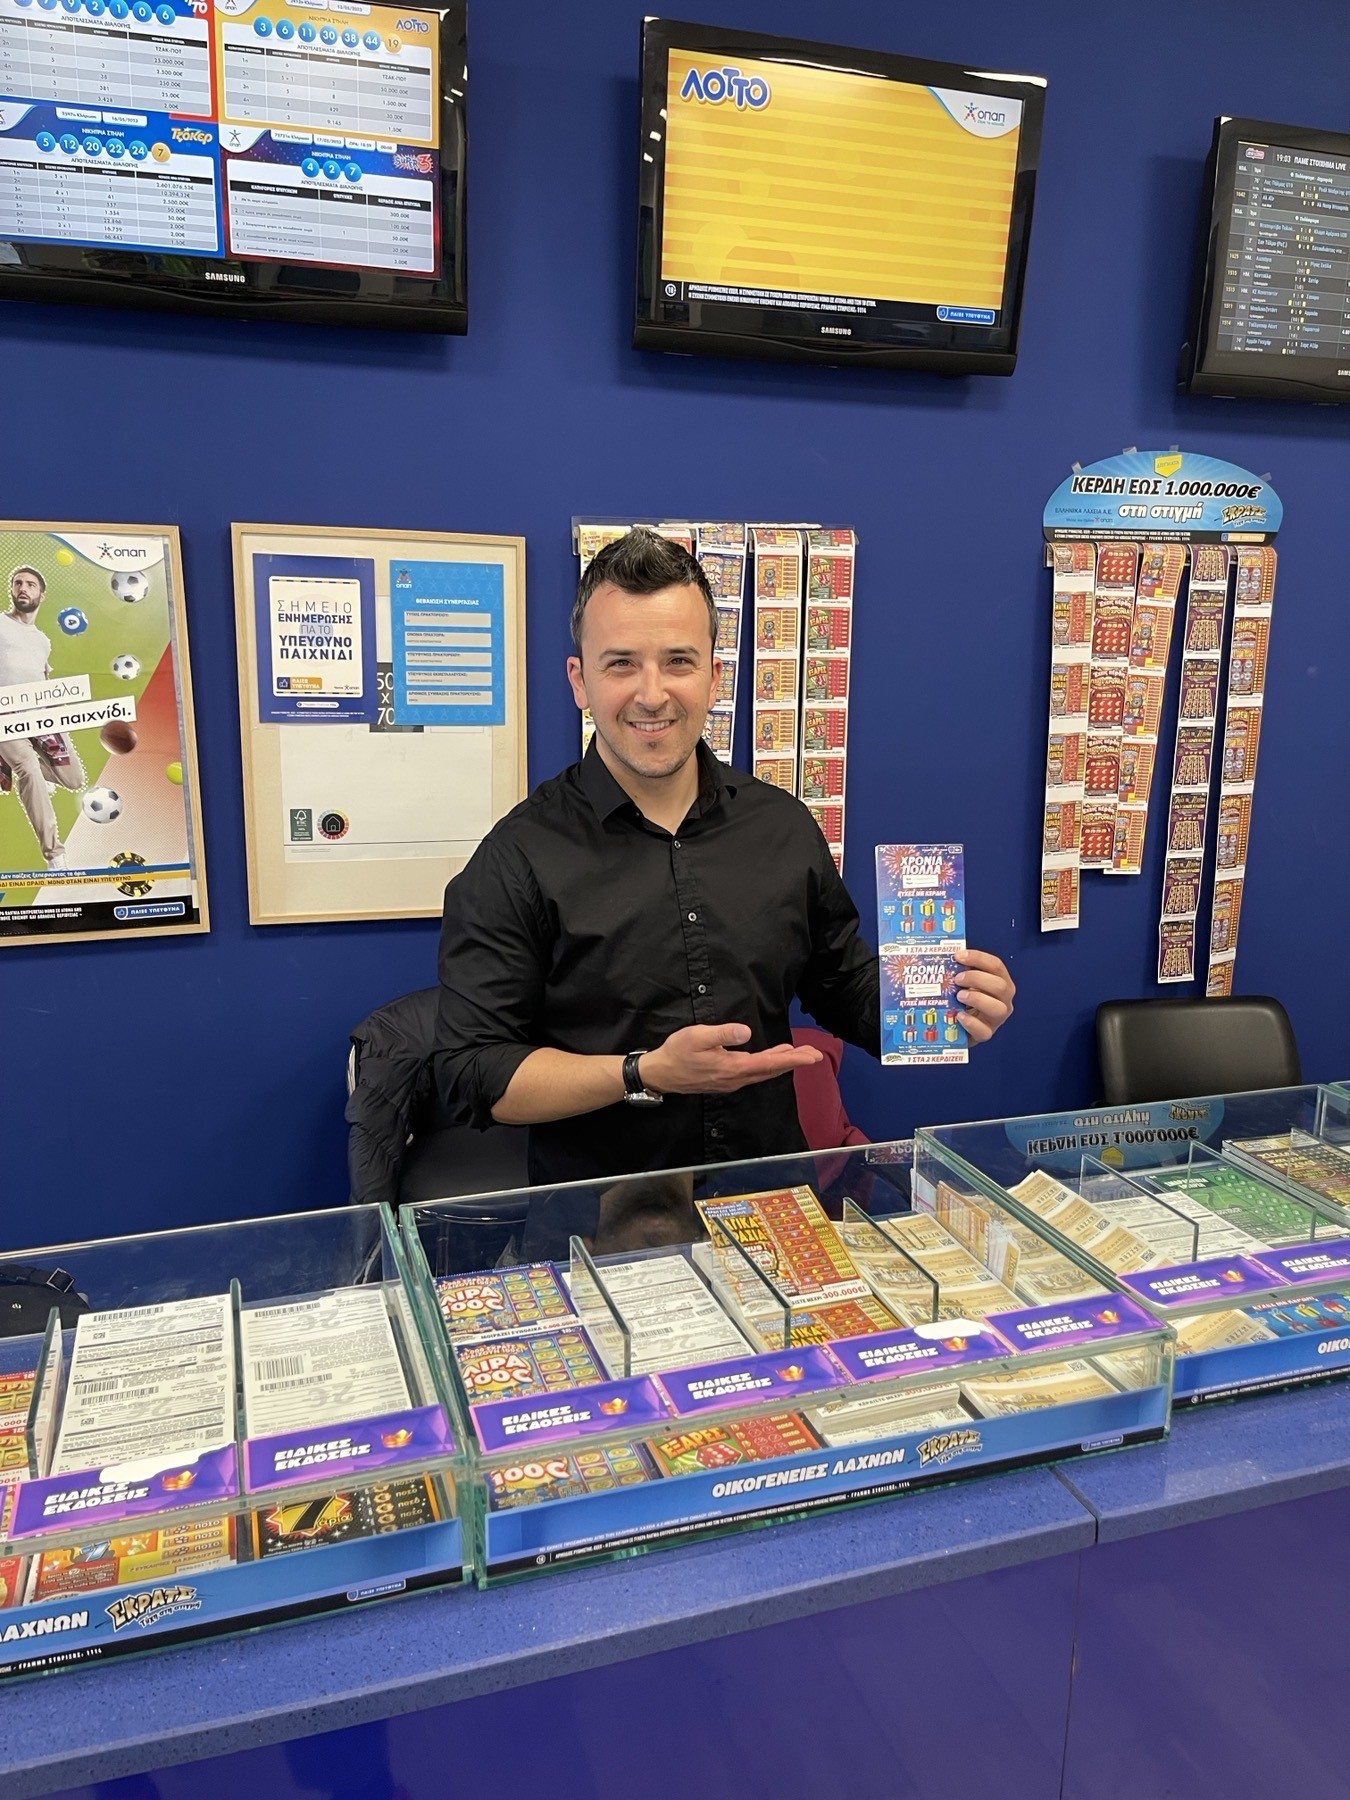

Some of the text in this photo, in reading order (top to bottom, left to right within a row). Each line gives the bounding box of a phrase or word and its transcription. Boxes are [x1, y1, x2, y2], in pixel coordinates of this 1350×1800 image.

[92, 1, 99, 11] 2
[116, 4, 122, 14] 1
[138, 7, 146, 17] 0
[162, 10, 170, 20] 6
[396, 18, 429, 34] ΛΟΤΤΟ
[260, 22, 399, 48] 3 6 11 30 38 44 19
[680, 66, 770, 109] ΛΟΤΤΟ
[42, 138, 164, 157] 5 12 20 22 24 7
[307, 162, 356, 176] 4 2 7
[1276, 154, 1347, 171] 19:03 ΠΑΜΕ ΣΤΟΙΧΗΜΑ LIVE
[205, 272, 246, 283] SAMSUNG
[965, 312, 991, 320] ΥΠΕΥΘΥΝΑ
[820, 326, 852, 336] SAMSUNG
[1071, 476, 1262, 499] ΚΕΡΔΗ ΕΩΣ 1.000.000€
[1054, 507, 1082, 515] ΕΛΛΗΝΙΚΑ
[1118, 501, 1204, 523] στη στιγμή
[1221, 504, 1268, 525] ΣΚΡΑΤΣ
[114, 547, 147, 558] οπαπ
[278, 600, 352, 614] ΣΗΜΕΙΟ
[444, 598, 479, 606] ΣΥΝΕΡΓΑΣΙΑΣ
[278, 613, 353, 624] ΕΝΗΜΕΡΩΣΗΣ
[301, 625, 331, 634] ΓΙΑ ΤΟ
[279, 635, 352, 647] ΥΠΕΥΘΥΝΟ
[280, 648, 352, 660] ΠΑΙΧΝΙΔΙ
[377, 673, 394, 690] 50
[20, 693, 29, 705] η
[34, 682, 85, 705] μπάλα,
[381, 692, 390, 704] x
[4, 702, 132, 735] και το παιχνίδι.
[377, 707, 395, 726] 70
[900, 856, 943, 866] ΧΡΟΝΙΑ
[12, 872, 32, 880] παίζεις
[32, 871, 67, 880] ξεπερνώντας
[902, 865, 941, 875] ΠΟΛΛΑ
[149, 906, 180, 914] ΥΠΕΥΘΥΝΑ
[910, 946, 923, 954] ΣΤΑ
[902, 965, 946, 975] ΧΡΟΝΙΑ
[904, 974, 944, 984] ΠΟΛΛΑ
[1281, 1254, 1332, 1268] ΕΙΔΙΚΕΣ
[1290, 1258, 1350, 1273] ΕΚΔΟΣΕΙΣ
[1149, 1275, 1201, 1290] ΕΙΔΙΚΕΣ
[1157, 1279, 1220, 1296] ΕΚΔΟΣΕΙΣ
[441, 1287, 499, 1307] ΛΙΡΑ
[822, 1286, 867, 1299] 300.000€!
[1015, 1315, 1074, 1333] ΕΙΔΙΚΕΣ
[1024, 1320, 1093, 1339] ΕΚΔΟΣΕΙΣ
[481, 1331, 511, 1340] ΜΟΙΡΑΖΕΙ
[511, 1326, 542, 1335] ΣΥΝΟΛΙΚΑ
[858, 1341, 919, 1360] ΕΙΔΙΚΕΣ
[864, 1346, 939, 1367] ΕΚΔΟΣΕΙΣ
[463, 1355, 527, 1378] ΛΙΡΑ
[687, 1372, 752, 1392] ΕΙΔΙΚΕΣ
[692, 1377, 773, 1400] ΕΚΔΟΣΕΙΣ
[501, 1405, 572, 1426] ΕΙΔΙΚΕΣ
[504, 1411, 592, 1435] ΕΚΔΟΣΕΙΣ
[274, 1438, 352, 1462] ΕΙΔΙΚΕΣ
[657, 1425, 730, 1459] ΕΞΑΡΕΣ
[916, 1430, 981, 1468] ΣΚΡΑΤΣ
[275, 1444, 371, 1471] ΕΚΔΟΣΕΙΣ
[712, 1448, 906, 1499] ΟΙΚΟΓΕΝΕΙΕΣ ΛΑΧΝΩΝ
[43, 1487, 150, 1516] ΕΚΔΟΣΕΙΣ
[45, 1481, 130, 1506] ΕΙΔΙΚΕΣ
[195, 1520, 222, 1529] ΠΟΣΟ
[195, 1530, 221, 1541] ΠΟΣΟ
[194, 1541, 220, 1551] ΠΟΣΟ
[105, 1586, 197, 1632] ΣΚΡΑΤΣ
[139, 1600, 202, 1628] Τύχη στη στιγμή
[18, 1658, 47, 1670] ΓΡΑΜΜΗ
[86, 1647, 103, 1656] 1114
